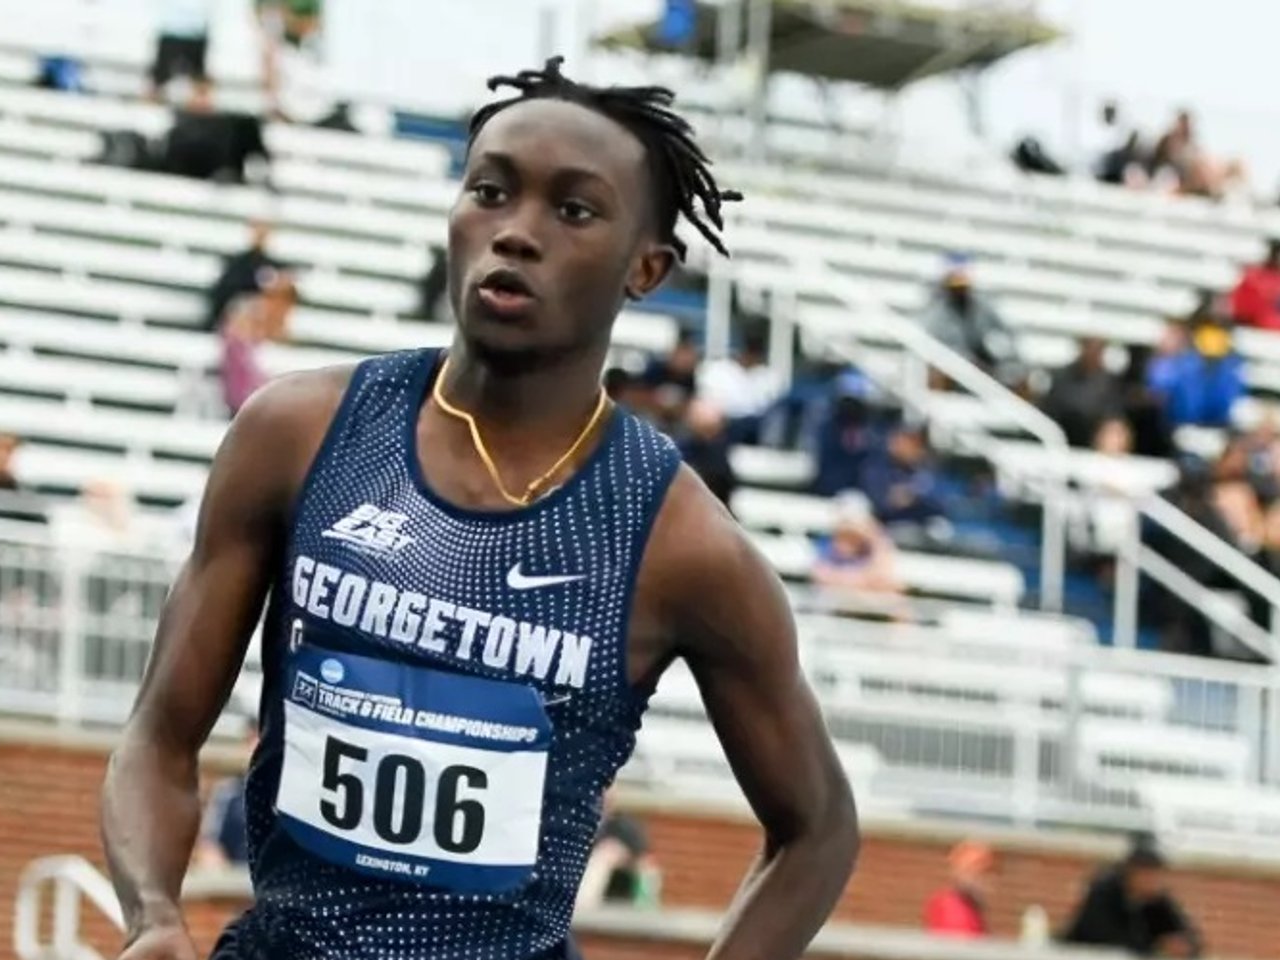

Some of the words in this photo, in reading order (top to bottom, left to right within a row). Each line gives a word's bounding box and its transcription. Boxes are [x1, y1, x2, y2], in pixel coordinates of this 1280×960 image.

[291, 554, 593, 689] GEORGETOWN
[318, 688, 361, 715] TRACK
[372, 703, 414, 725] FIELD
[414, 710, 539, 743] CHAMPIONSHIPS
[320, 734, 489, 855] 506
